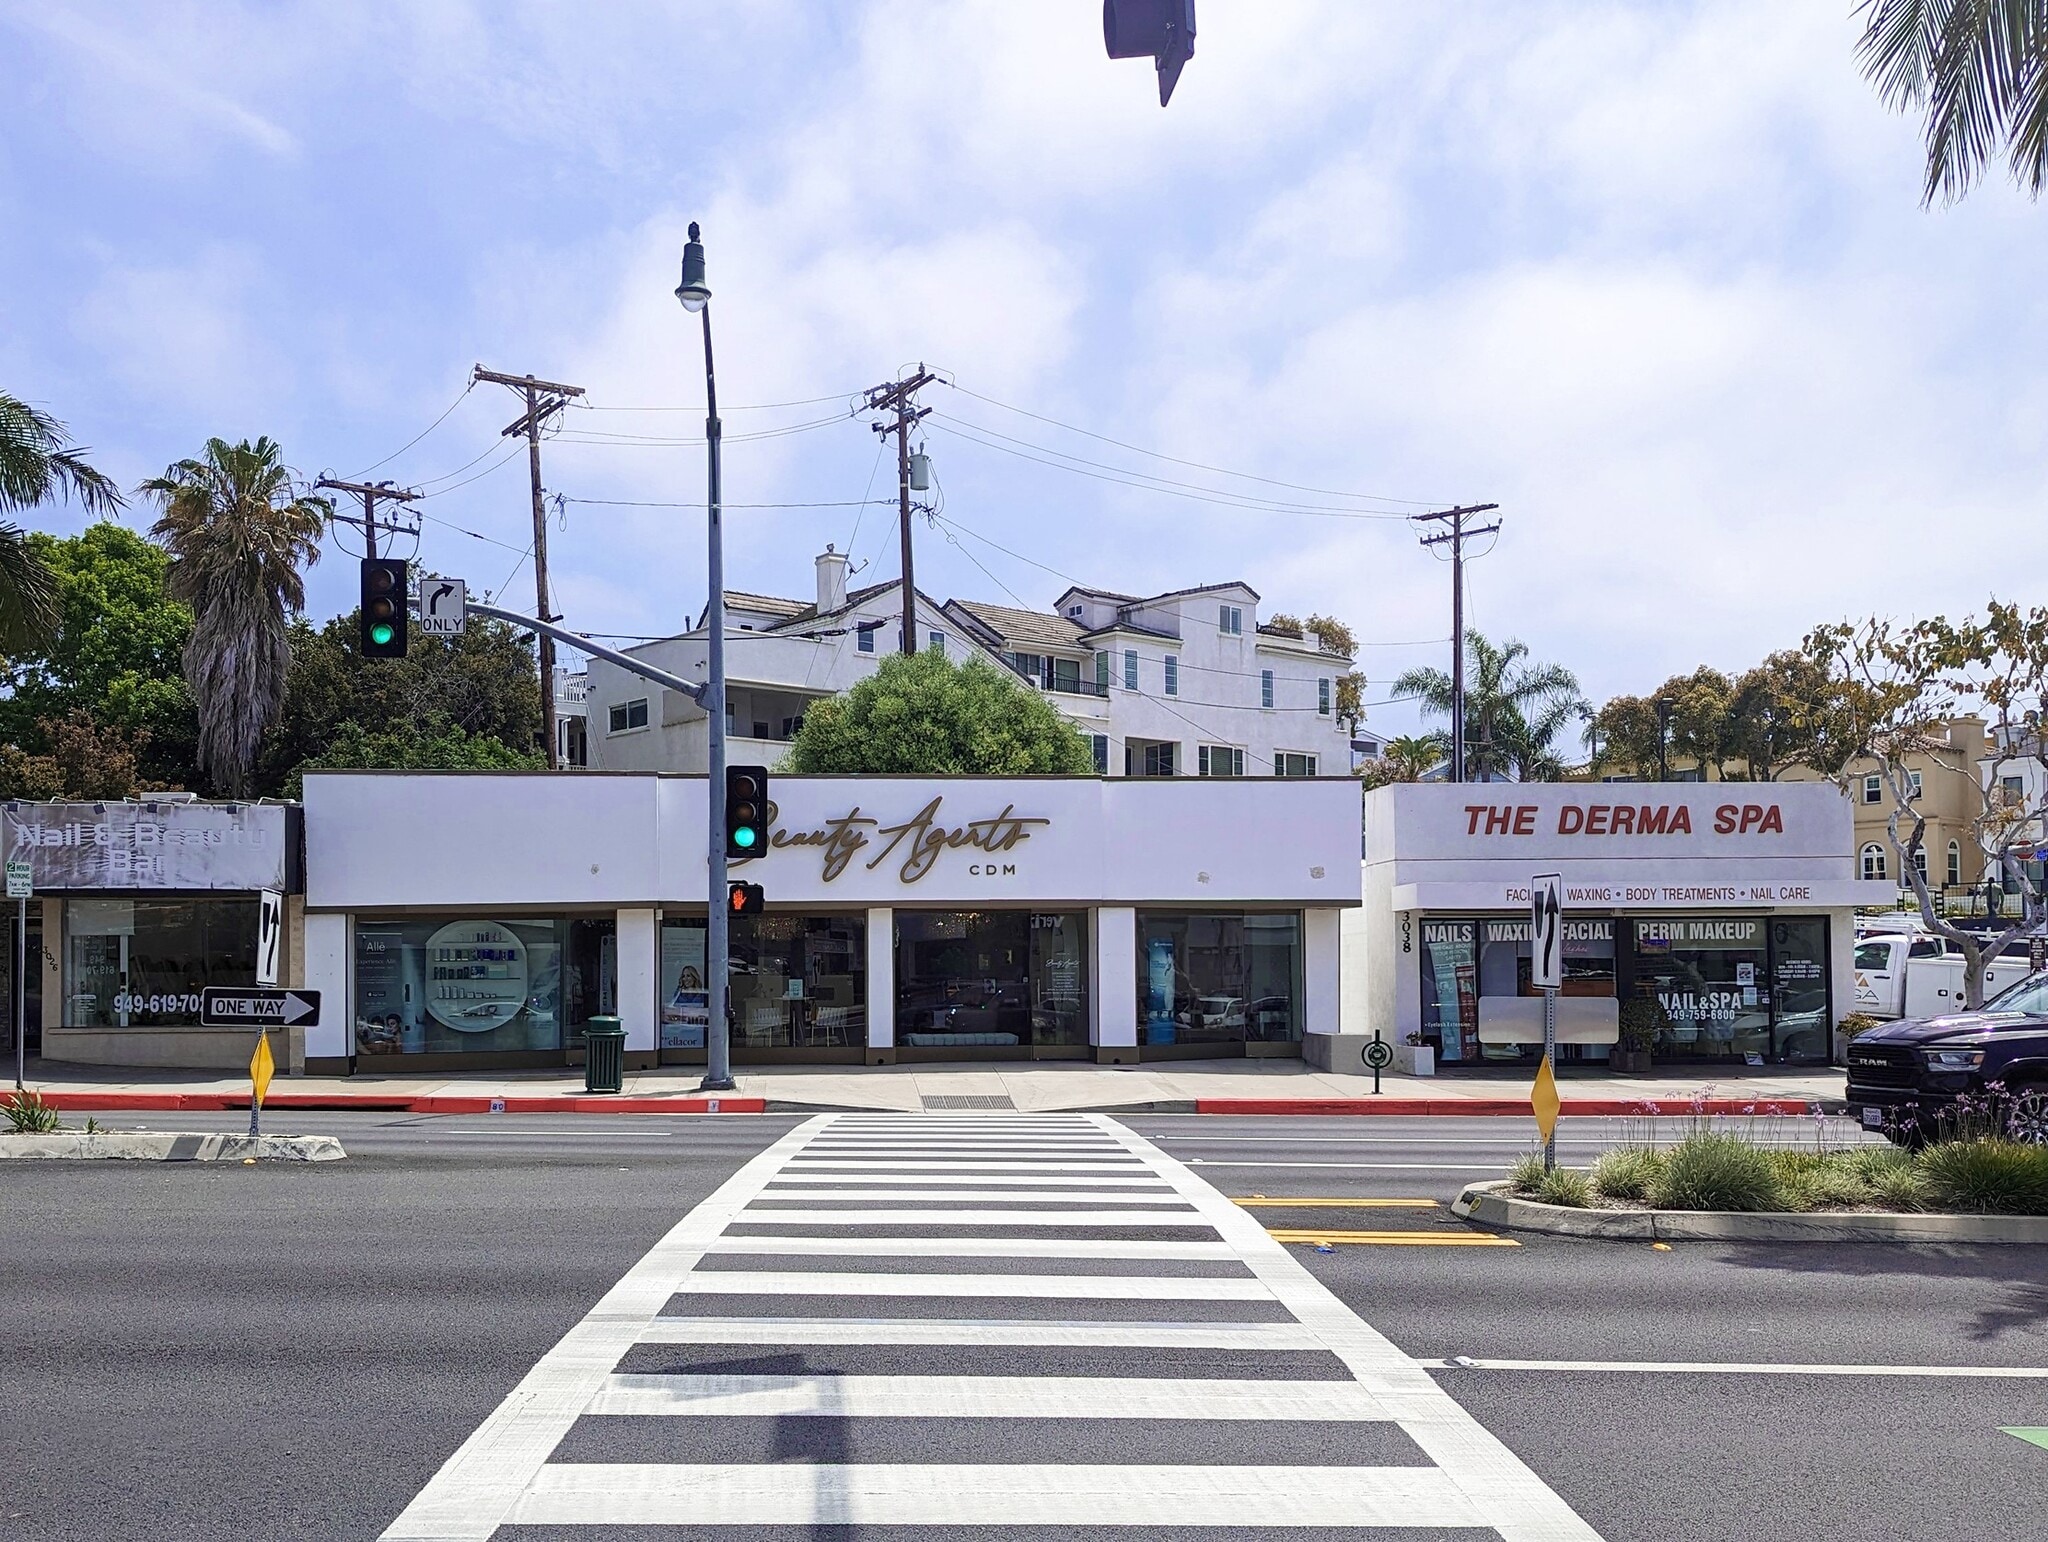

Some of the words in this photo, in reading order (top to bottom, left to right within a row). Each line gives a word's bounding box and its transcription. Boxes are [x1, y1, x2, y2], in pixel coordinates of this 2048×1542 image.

[423, 618, 462, 631] ONLY
[1464, 805, 1539, 835] THE
[1557, 805, 1692, 834] DERMA
[1713, 804, 1784, 834] SPA
[18, 823, 81, 846] Nail
[93, 823, 112, 846] &
[135, 823, 267, 850] Beauty
[866, 796, 1051, 884] Agents
[8, 862, 15, 871] 2
[110, 850, 166, 873] Bar
[969, 864, 1016, 876] CDM
[1566, 888, 1611, 901] WAXING
[1626, 887, 1657, 901] BODY
[1662, 887, 1735, 900] TREATMENTS
[1750, 887, 1775, 900] NAIL
[1780, 887, 1810, 900] CARE
[1402, 911, 1411, 953] 3038
[1424, 924, 1472, 942] NAILS
[1561, 922, 1613, 940] FACIAL
[1638, 922, 1684, 940] PERM
[1689, 922, 1756, 940] MAKEUP
[42, 946, 58, 971] 3026
[114, 995, 204, 1013] 949-619-70
[215, 1000, 247, 1014] ONE
[252, 1001, 285, 1015] WAY
[669, 1036, 698, 1046] ellacor
[1859, 1057, 1888, 1067] RAM
